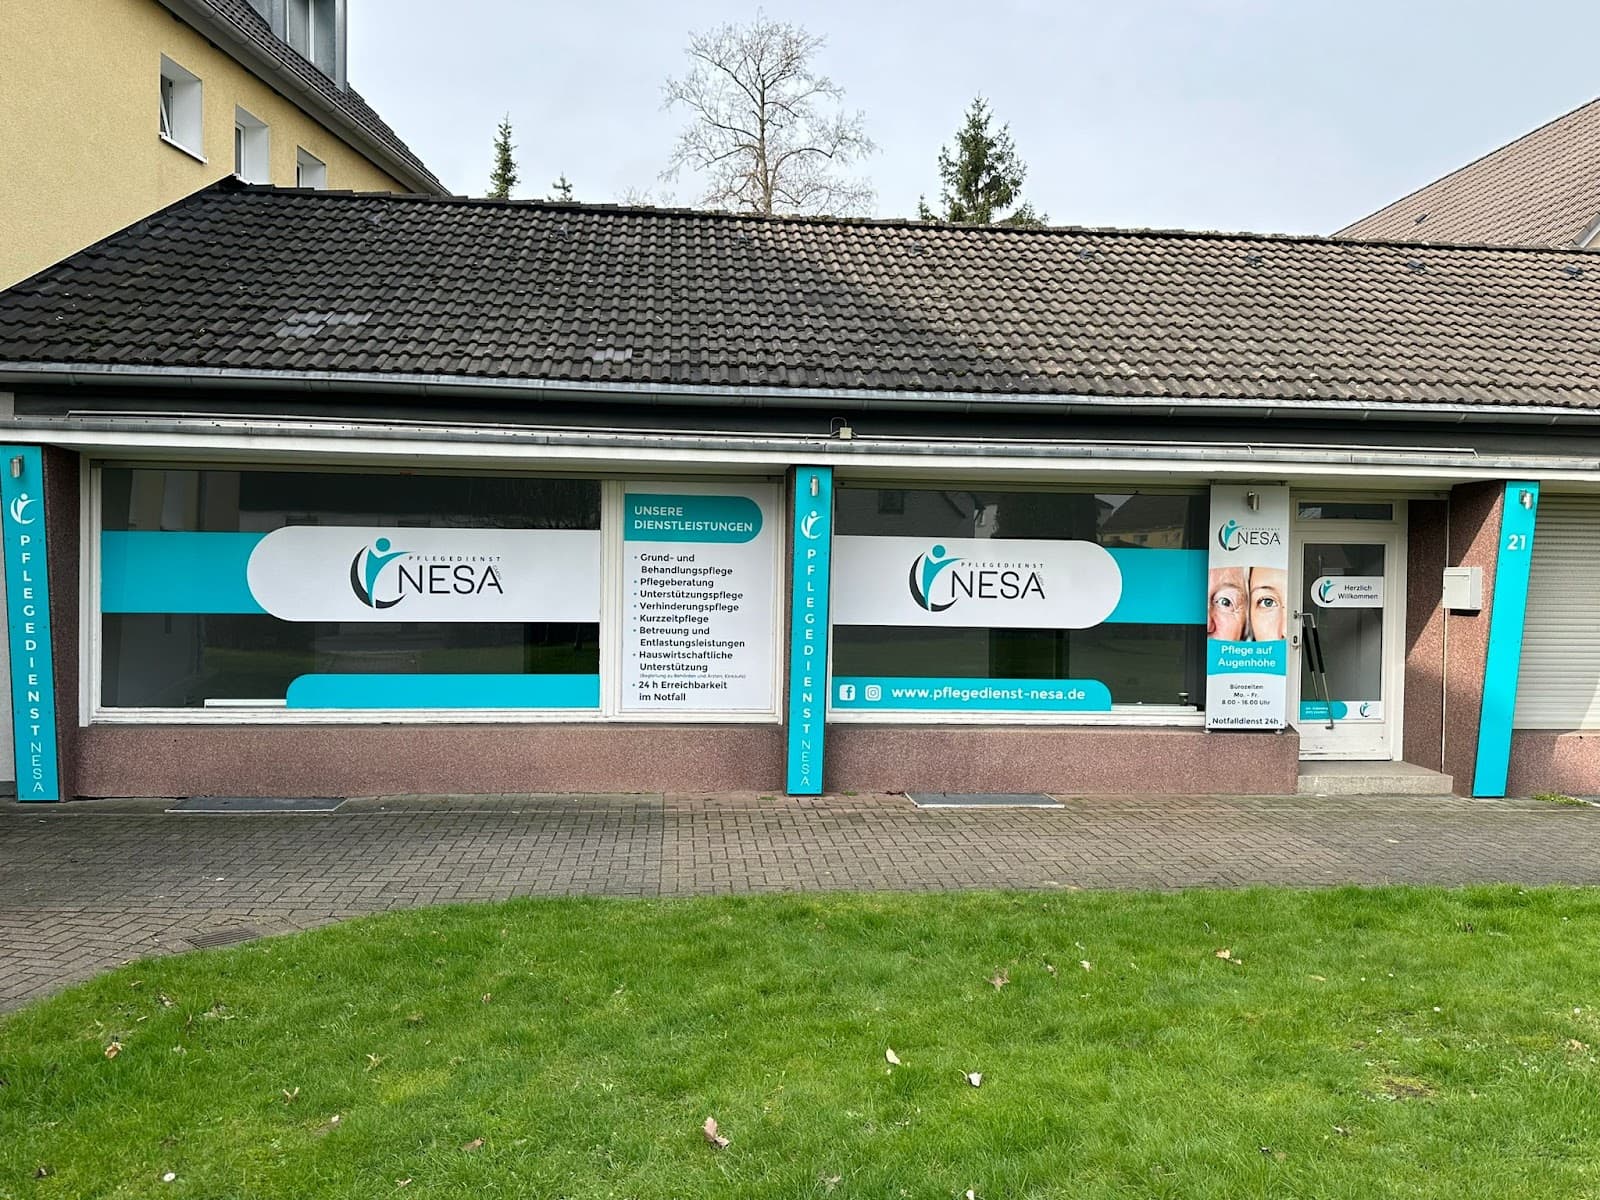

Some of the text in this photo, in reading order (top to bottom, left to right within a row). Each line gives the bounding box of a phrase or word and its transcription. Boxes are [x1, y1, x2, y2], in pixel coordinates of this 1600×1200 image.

[634, 506, 683, 516] UNSERE
[634, 519, 753, 532] DIENSTLEISTUNGEN
[1237, 531, 1281, 546] NESA
[1507, 534, 1527, 551] 21
[640, 553, 695, 562] Grund- und
[641, 566, 734, 577] Behandlungspflege
[398, 564, 504, 595] NESA
[640, 578, 714, 589] Pflegeberatung
[951, 570, 1046, 600] NESA
[640, 590, 744, 601] Unterstützungspflege
[639, 602, 740, 613] Verhinderungspflege
[639, 614, 710, 625] Kurzzeitpflege
[20, 535, 42, 737] PFLEGEDIENST
[639, 626, 710, 637] Betreuung und
[640, 638, 746, 649] Entlastungsleistungen
[802, 548, 817, 734] PFLEGEDIENST
[639, 650, 734, 660] Hauswirtschaftliche
[1221, 645, 1273, 657] Pflege auf
[640, 662, 708, 673] Unterstützung
[1218, 657, 1277, 669] Augenhöhe
[638, 680, 728, 689] 24 h Erreichbarkeit
[639, 693, 686, 701] im Notfall
[891, 685, 1087, 702] www.pflegedienst-nesa.de
[1212, 717, 1279, 725] Notfalldienst 24h
[31, 741, 45, 793] NESA
[800, 738, 812, 787] NESA
